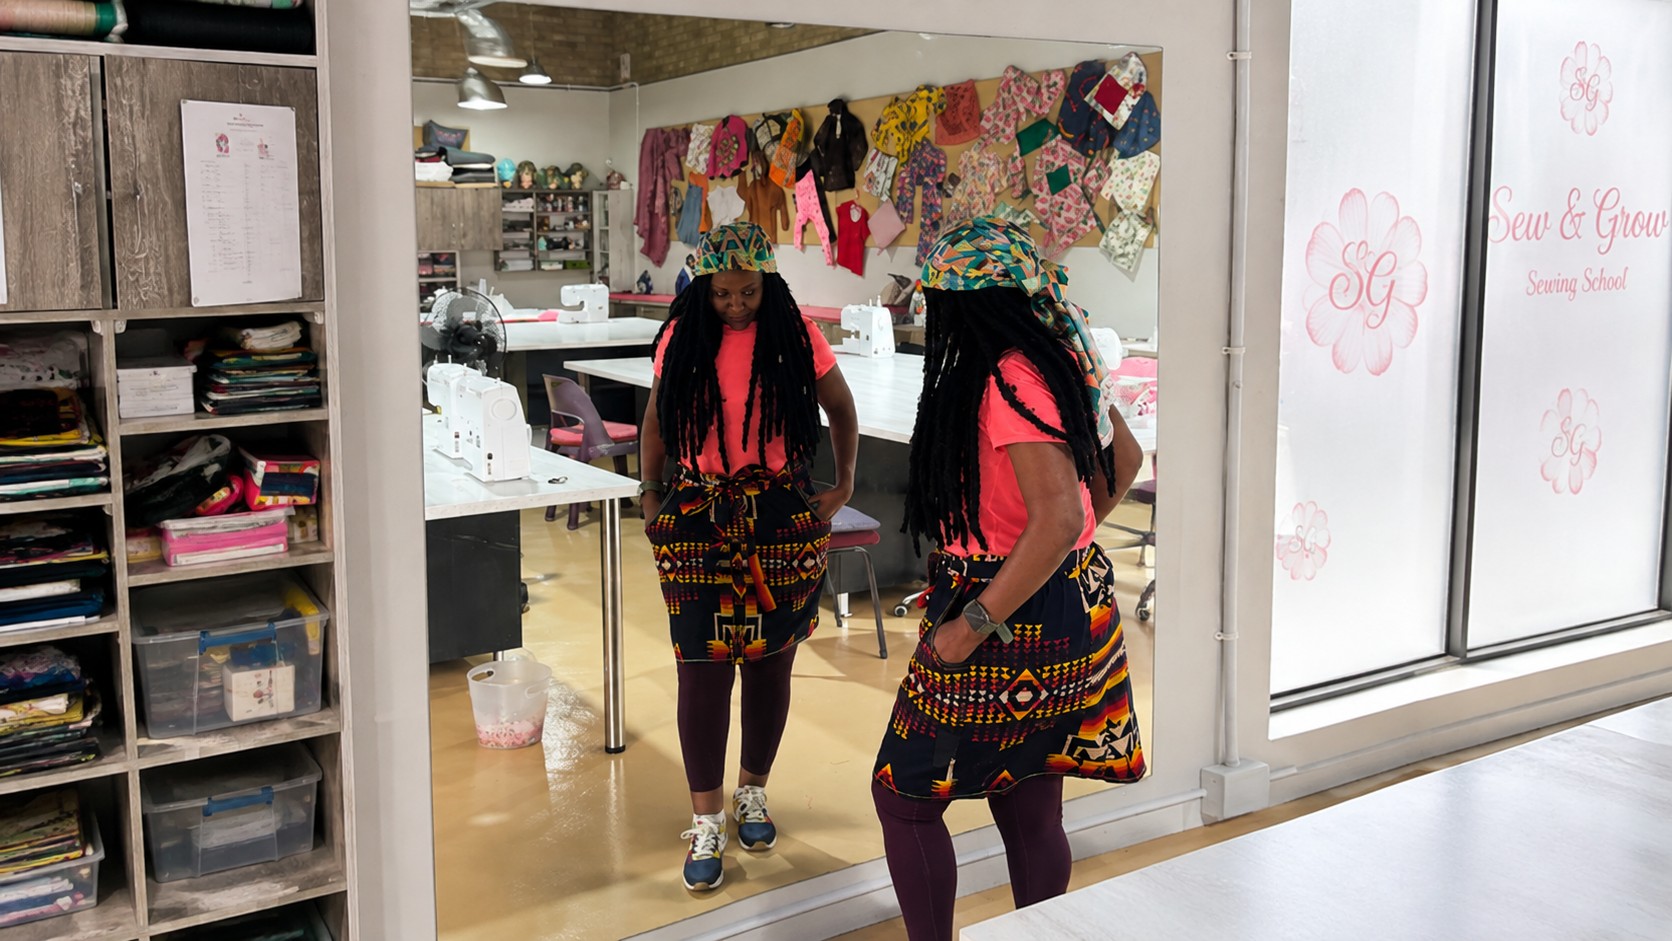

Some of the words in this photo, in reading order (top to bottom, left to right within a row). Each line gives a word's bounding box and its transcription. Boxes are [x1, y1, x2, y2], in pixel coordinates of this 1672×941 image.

[1569, 66, 1601, 112] SG
[1488, 185, 1551, 243] Sew
[1559, 187, 1586, 240] &
[1593, 187, 1668, 255] Grow
[1328, 240, 1396, 329] SG
[1526, 269, 1578, 301] Sewing
[1582, 266, 1629, 293] School
